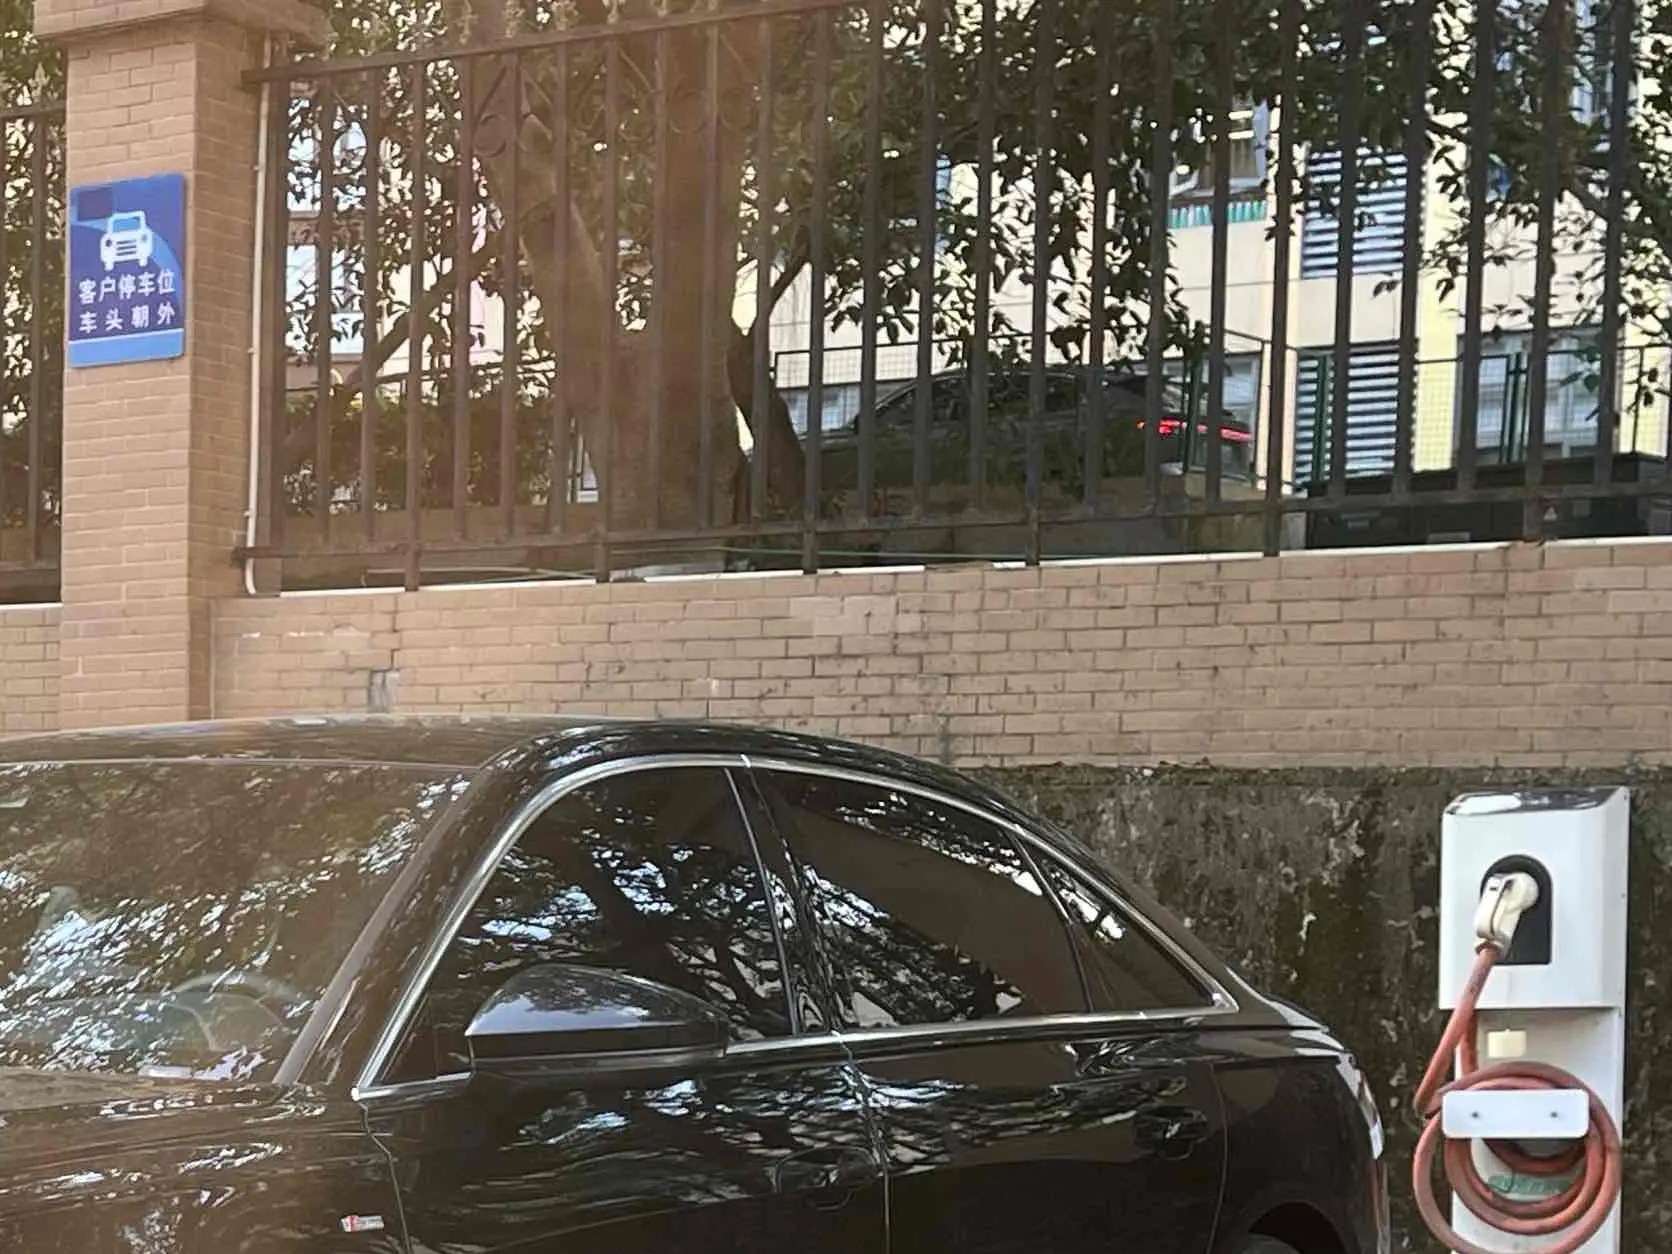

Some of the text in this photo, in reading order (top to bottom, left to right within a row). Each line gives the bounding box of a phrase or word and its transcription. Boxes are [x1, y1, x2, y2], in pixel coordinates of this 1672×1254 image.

[79, 268, 176, 305] 客户停车位
[79, 301, 175, 334] 车头朝外
